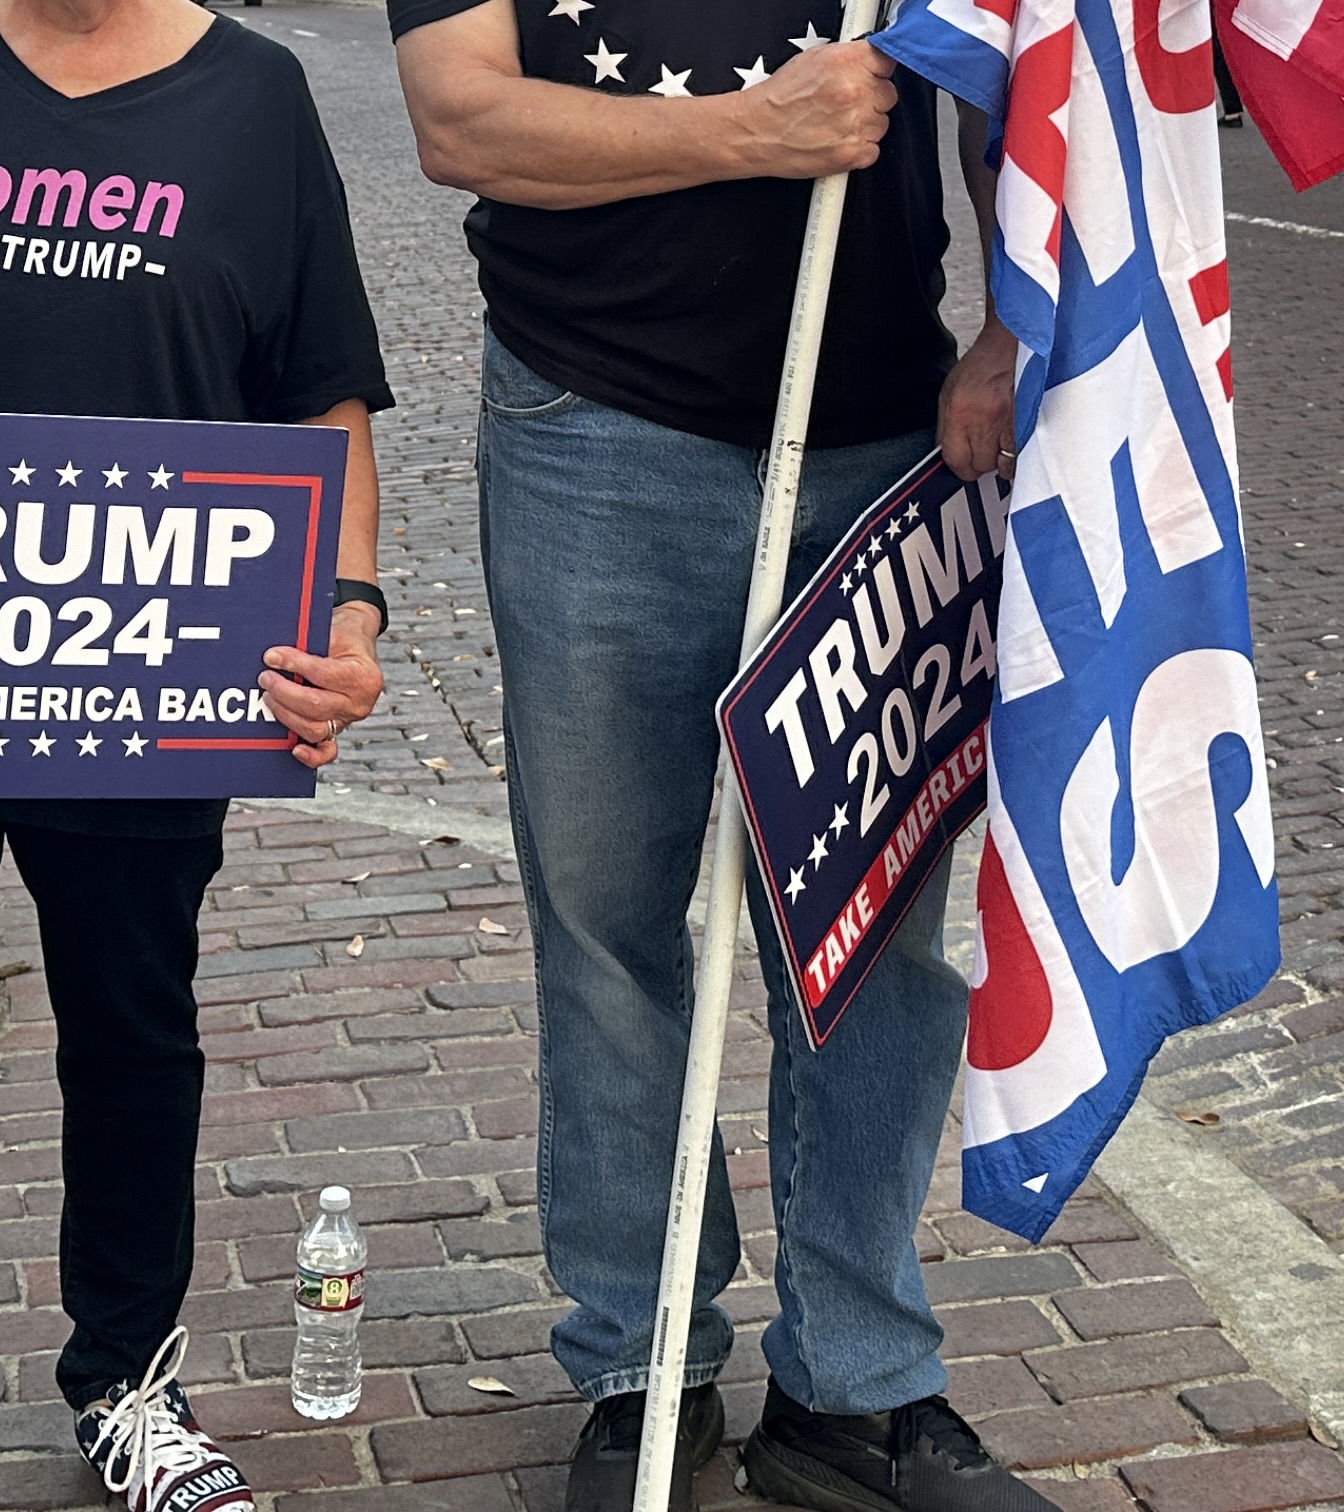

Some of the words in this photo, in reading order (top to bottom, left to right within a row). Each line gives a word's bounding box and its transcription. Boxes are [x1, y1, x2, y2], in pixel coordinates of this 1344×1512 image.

[158, 687, 275, 723] BACK
[847, 598, 998, 839] 2024
[808, 883, 874, 993] TAKE
[883, 726, 987, 888] AMERIC
[162, 1465, 240, 1512] TRUMP
